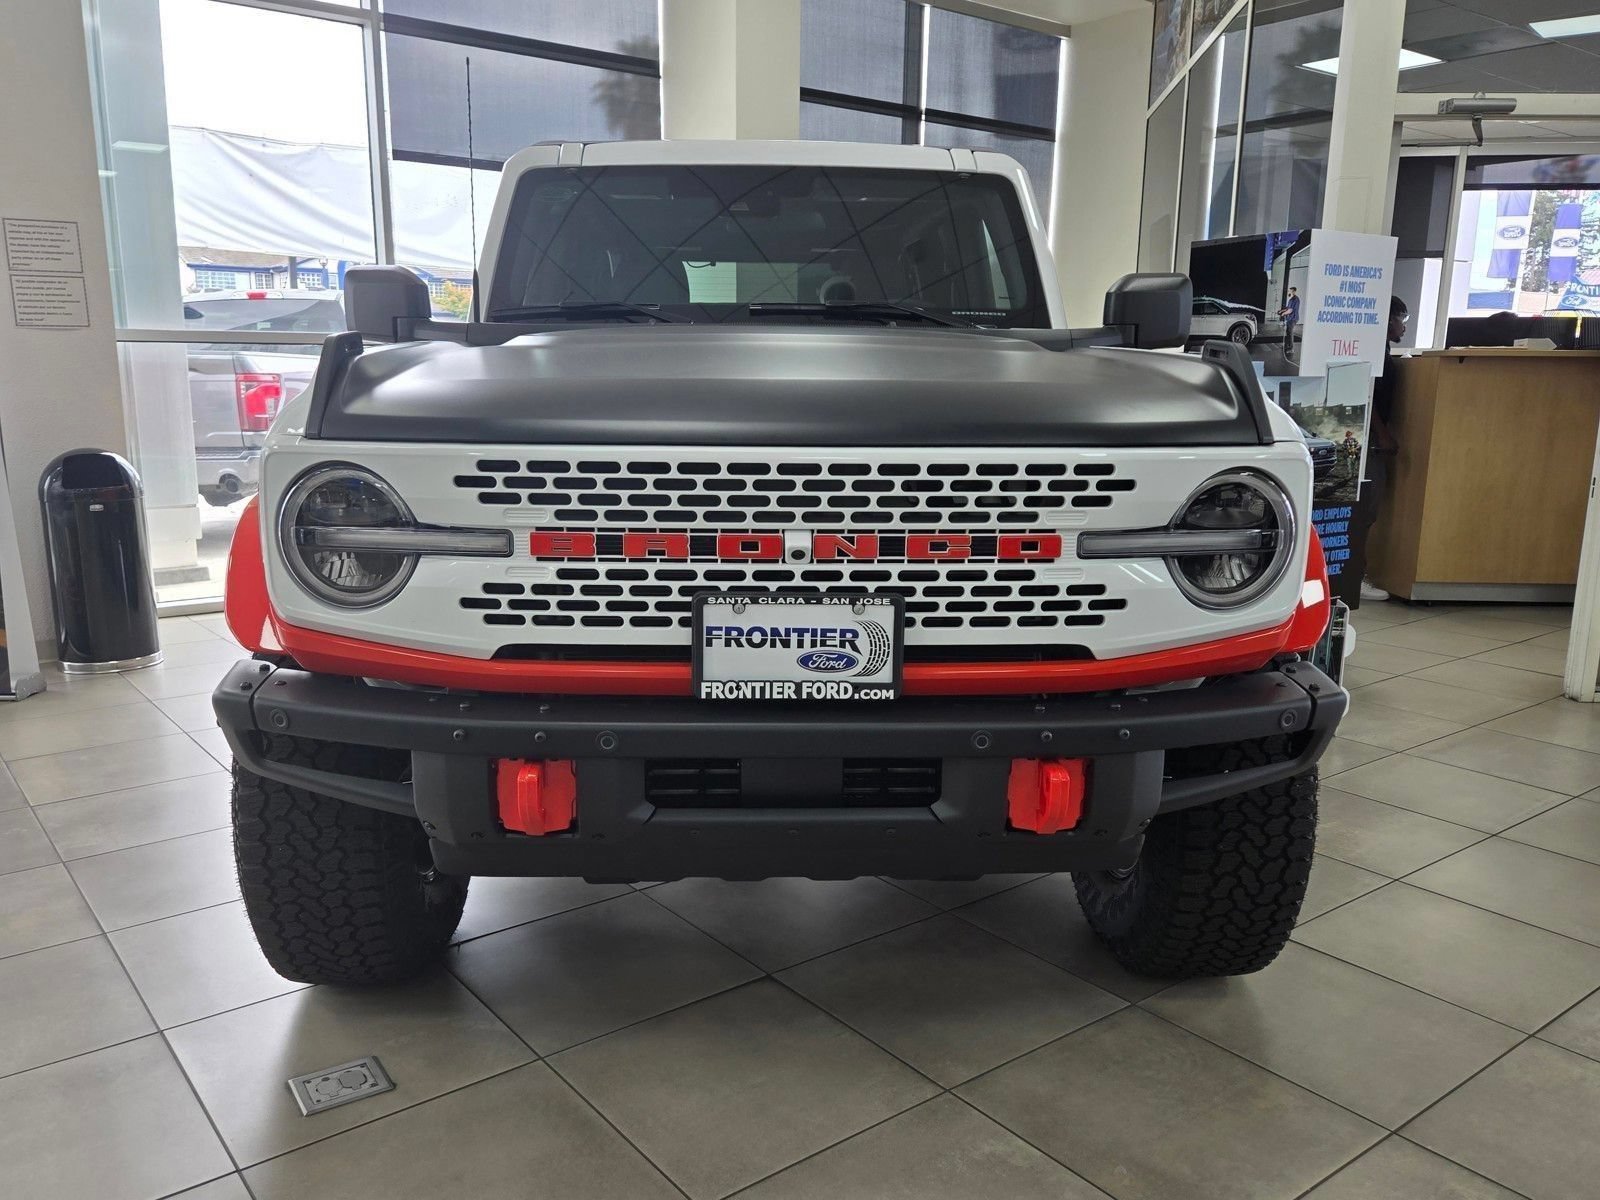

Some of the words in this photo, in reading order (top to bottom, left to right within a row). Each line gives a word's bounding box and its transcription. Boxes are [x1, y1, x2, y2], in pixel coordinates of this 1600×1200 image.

[1324, 263, 1342, 276] FORD
[1342, 264, 1349, 277] IS
[1349, 265, 1383, 279] AMERICA'S
[1339, 280, 1347, 292] #1
[1348, 281, 1366, 293] MOST
[1324, 295, 1346, 308] ICONIC
[1347, 296, 1377, 309] COMPANY
[1317, 310, 1354, 324] ACCORDING
[1354, 312, 1363, 324] TO
[1363, 312, 1380, 325] TIME.
[1332, 339, 1360, 356] TIME
[1324, 506, 1352, 520] EMPLOYS
[1325, 520, 1349, 534] HOURLY
[529, 531, 1062, 559] BRONCO
[1330, 548, 1350, 561] OTHER
[707, 597, 751, 605] SANTA
[758, 597, 805, 605] CLARA
[822, 597, 849, 605] SAN
[705, 625, 863, 656] FRONTIER
[701, 681, 796, 700] FRONTIER
